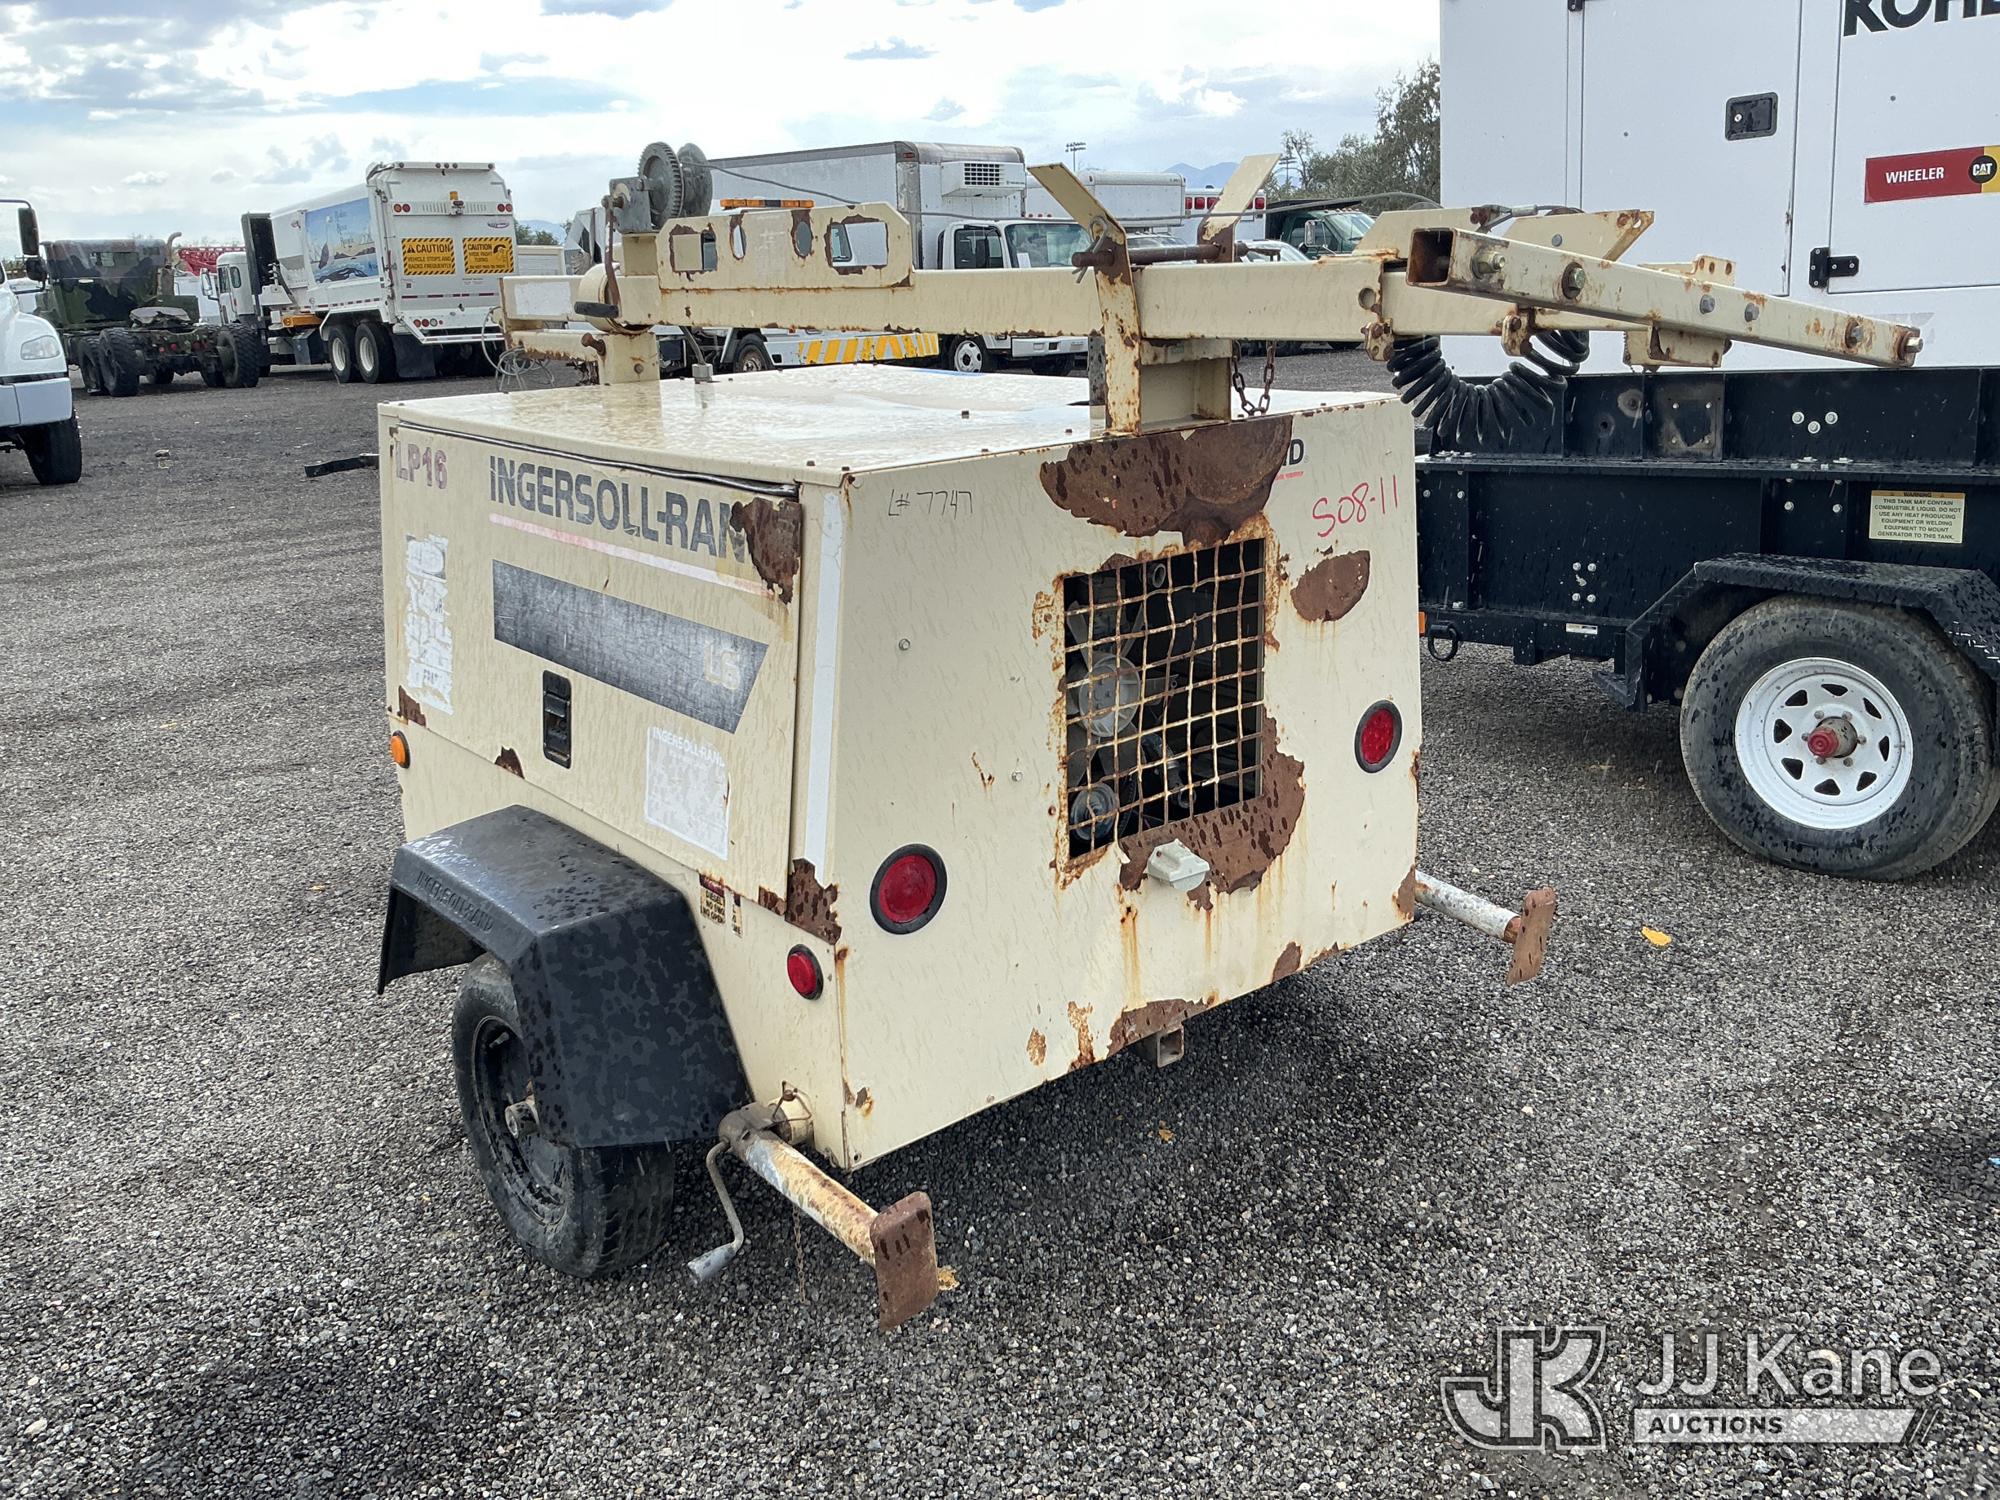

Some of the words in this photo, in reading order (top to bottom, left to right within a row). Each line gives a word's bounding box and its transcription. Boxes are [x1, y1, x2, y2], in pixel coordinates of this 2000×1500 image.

[1886, 167, 1944, 184] WHEELER
[1972, 163, 1992, 176] CAT
[416, 244, 450, 253] CAUTION
[395, 440, 448, 490] LP16
[1312, 474, 1398, 537] S08-11
